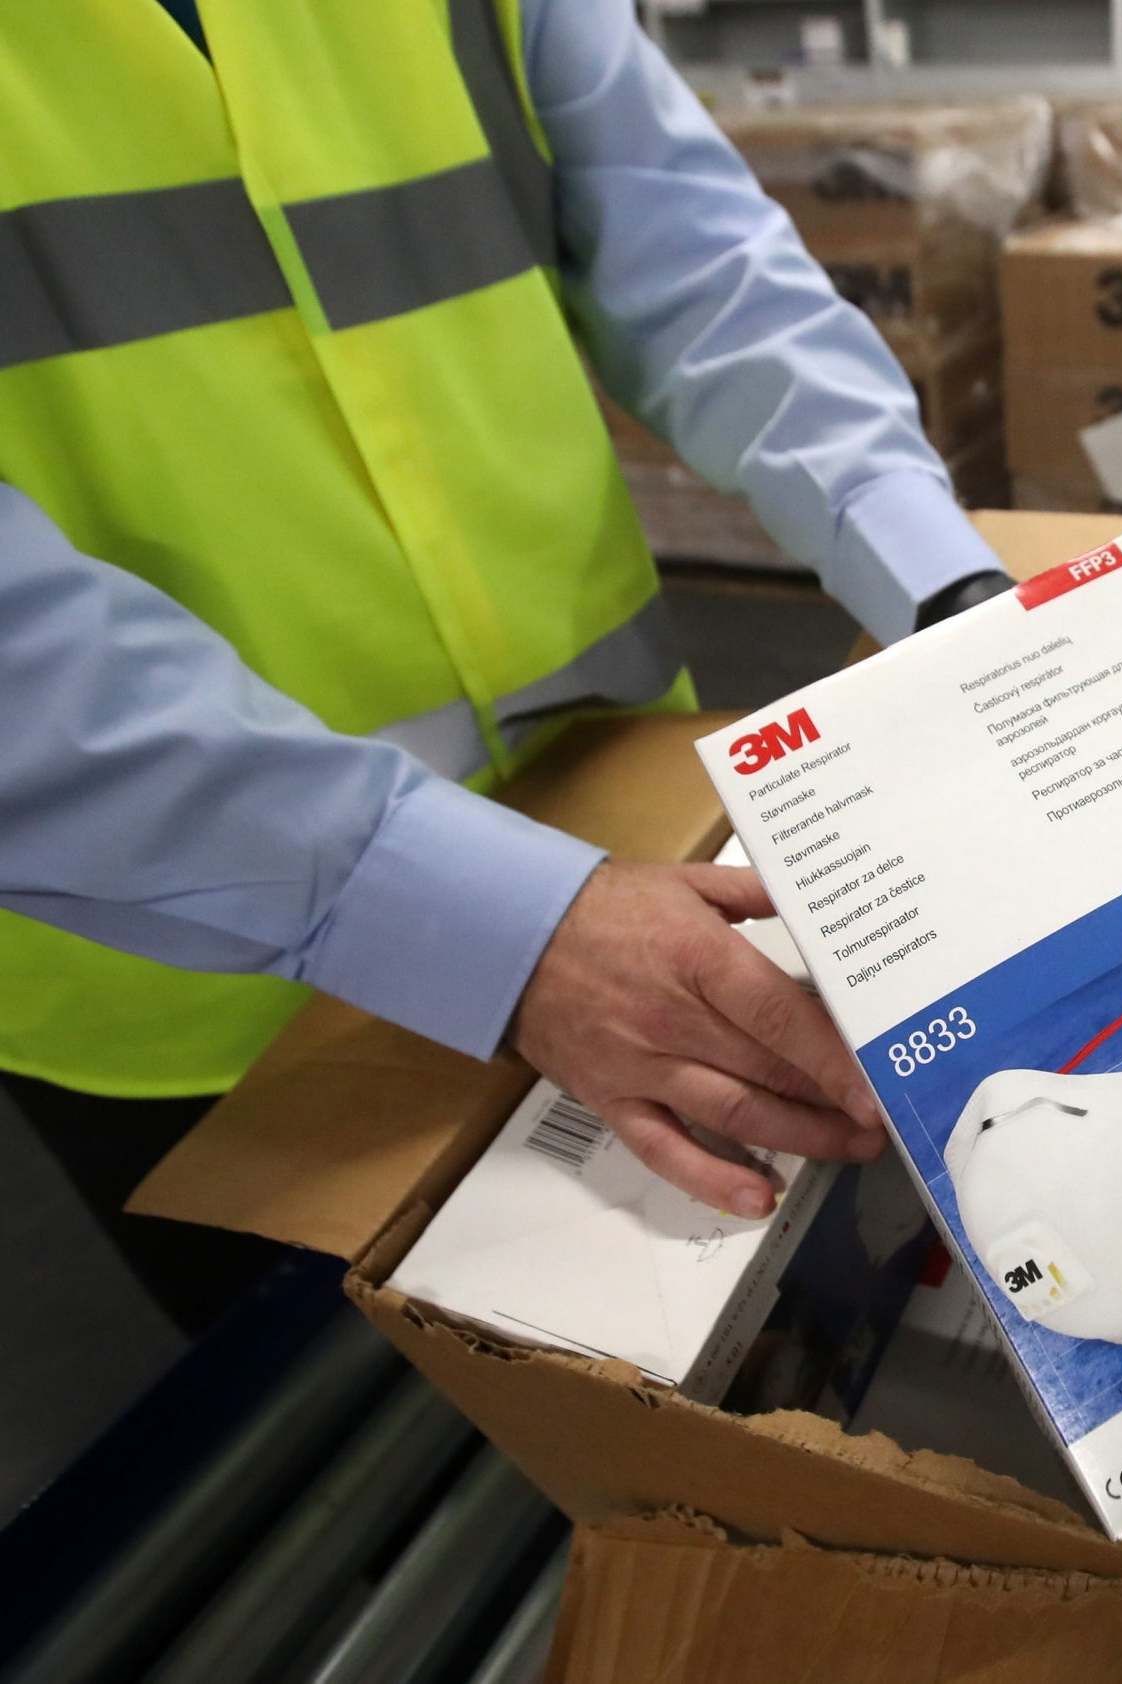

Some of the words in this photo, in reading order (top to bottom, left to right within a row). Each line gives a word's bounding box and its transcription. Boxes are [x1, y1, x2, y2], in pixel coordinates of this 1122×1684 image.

[1068, 550, 1117, 582] FFP3
[960, 659, 1022, 694] Respiratorius
[1022, 649, 1041, 664] nuo
[986, 702, 1041, 736] Полумаска
[1042, 669, 1111, 708] фильтрующая
[728, 706, 821, 775] 3M
[996, 715, 1049, 747] аэрозолей
[1010, 722, 1092, 768] аэрозольдардан
[748, 767, 801, 801] Particulate
[800, 742, 852, 773] Respirator
[1018, 744, 1077, 781] респиратор
[1031, 766, 1093, 801] Респиратор
[1094, 758, 1107, 771] за
[760, 787, 816, 823] Støvmaske
[771, 811, 825, 845] Filtrerande
[825, 784, 874, 816] halvmask
[784, 830, 841, 867] Støvmaske
[795, 842, 872, 891] Hiukkassuojain
[807, 878, 860, 914] Respirator
[862, 871, 876, 884] za
[876, 854, 905, 875] delce
[820, 903, 873, 938] Respirator
[875, 895, 889, 908] za
[888, 872, 926, 899] čestice
[833, 906, 921, 962] Tolmurespiraator
[846, 962, 882, 989] Daļiņu
[882, 928, 938, 968] respirators
[888, 1006, 977, 1077] 8833
[1004, 1258, 1043, 1293] 3M
